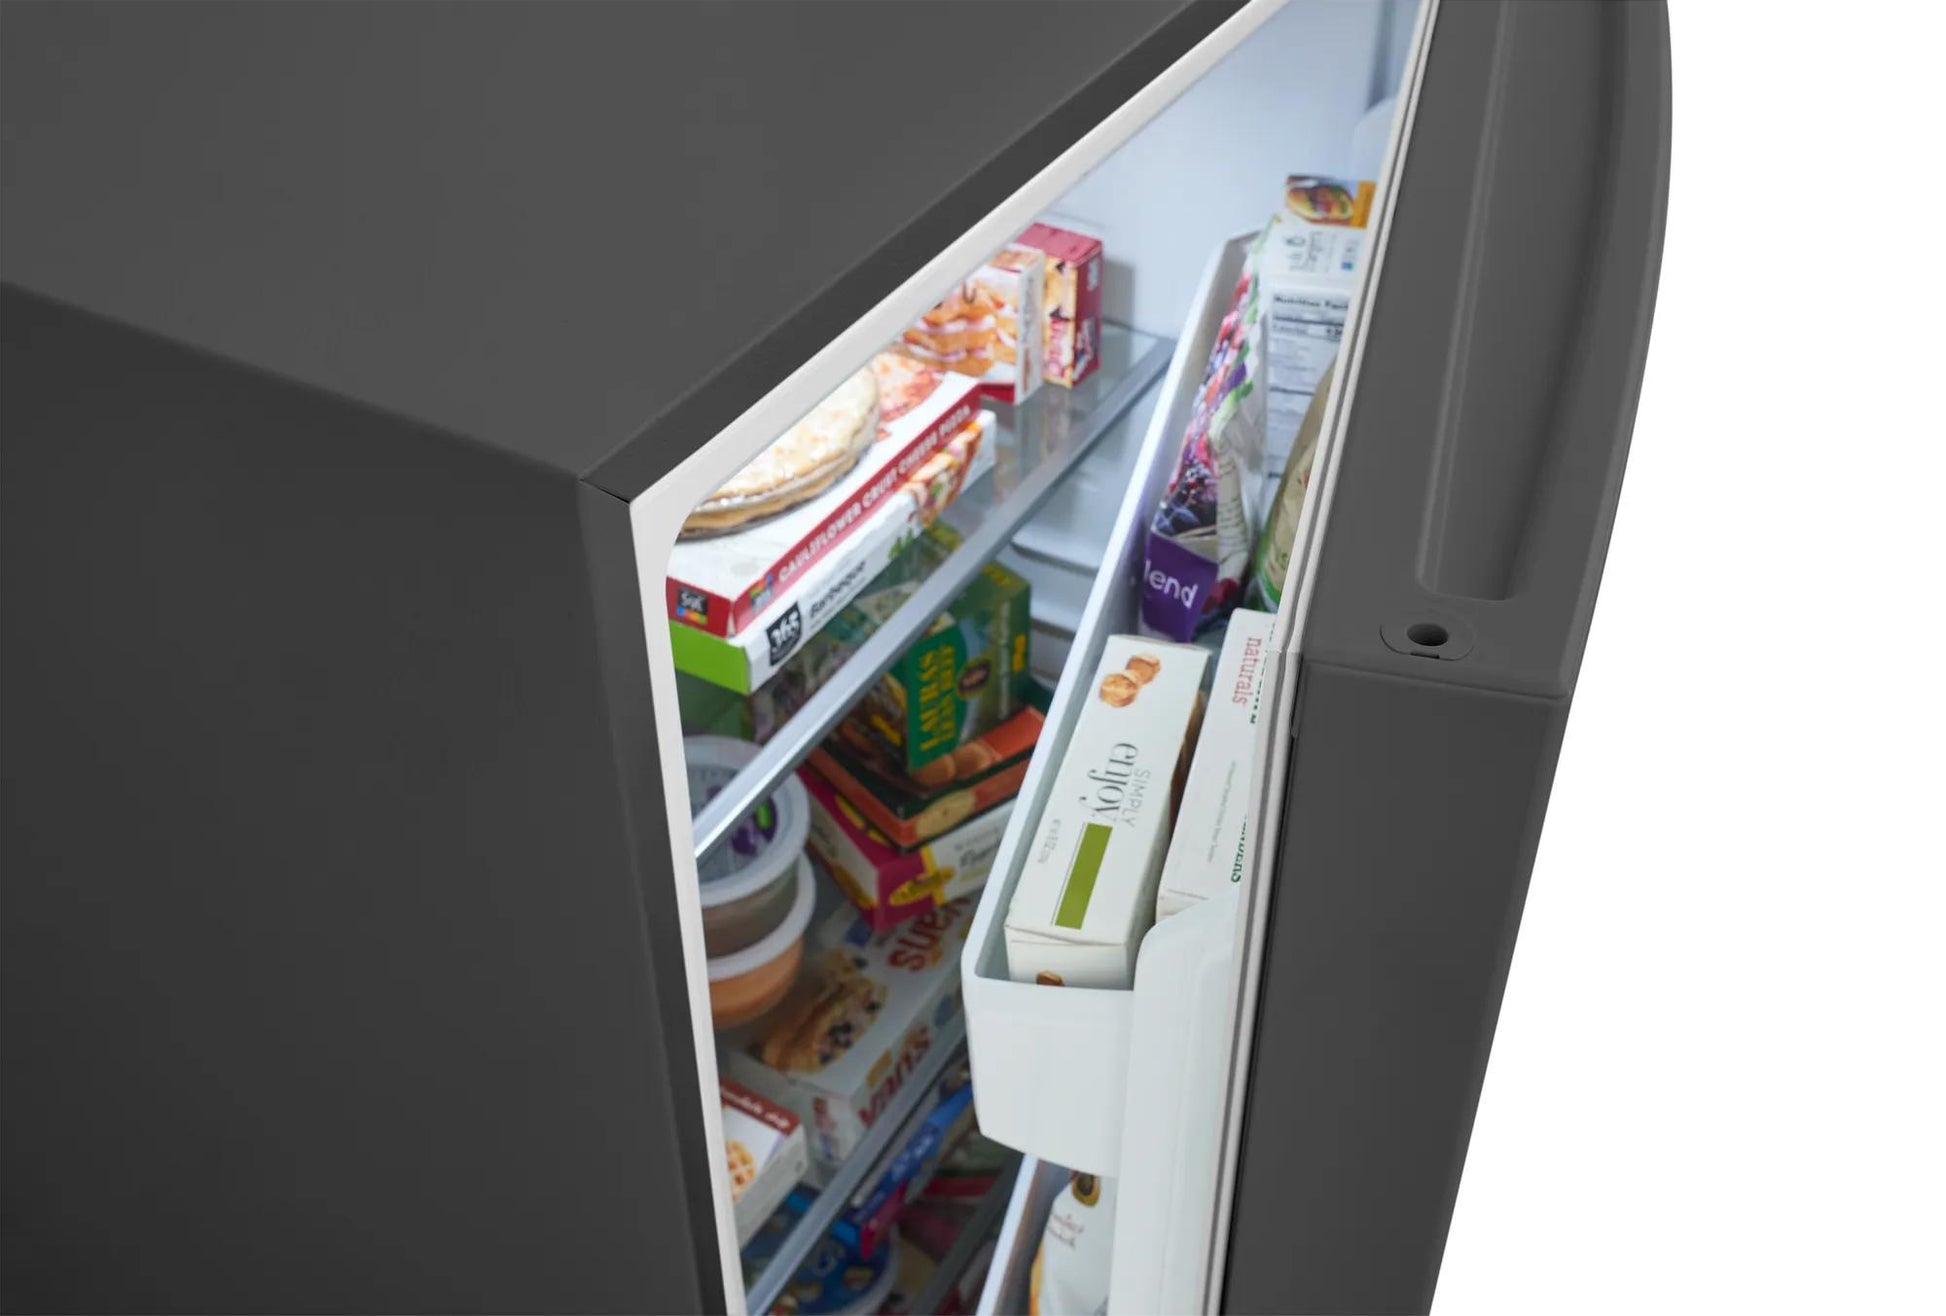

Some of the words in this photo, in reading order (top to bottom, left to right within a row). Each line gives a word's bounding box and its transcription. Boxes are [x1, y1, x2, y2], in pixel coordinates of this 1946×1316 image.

[777, 501, 862, 583] CAULIFLOWER
[862, 467, 899, 508] CRUST
[1231, 636, 1263, 707] naturals
[1078, 741, 1140, 820] enjoy
[1126, 767, 1151, 829] SIMPLY
